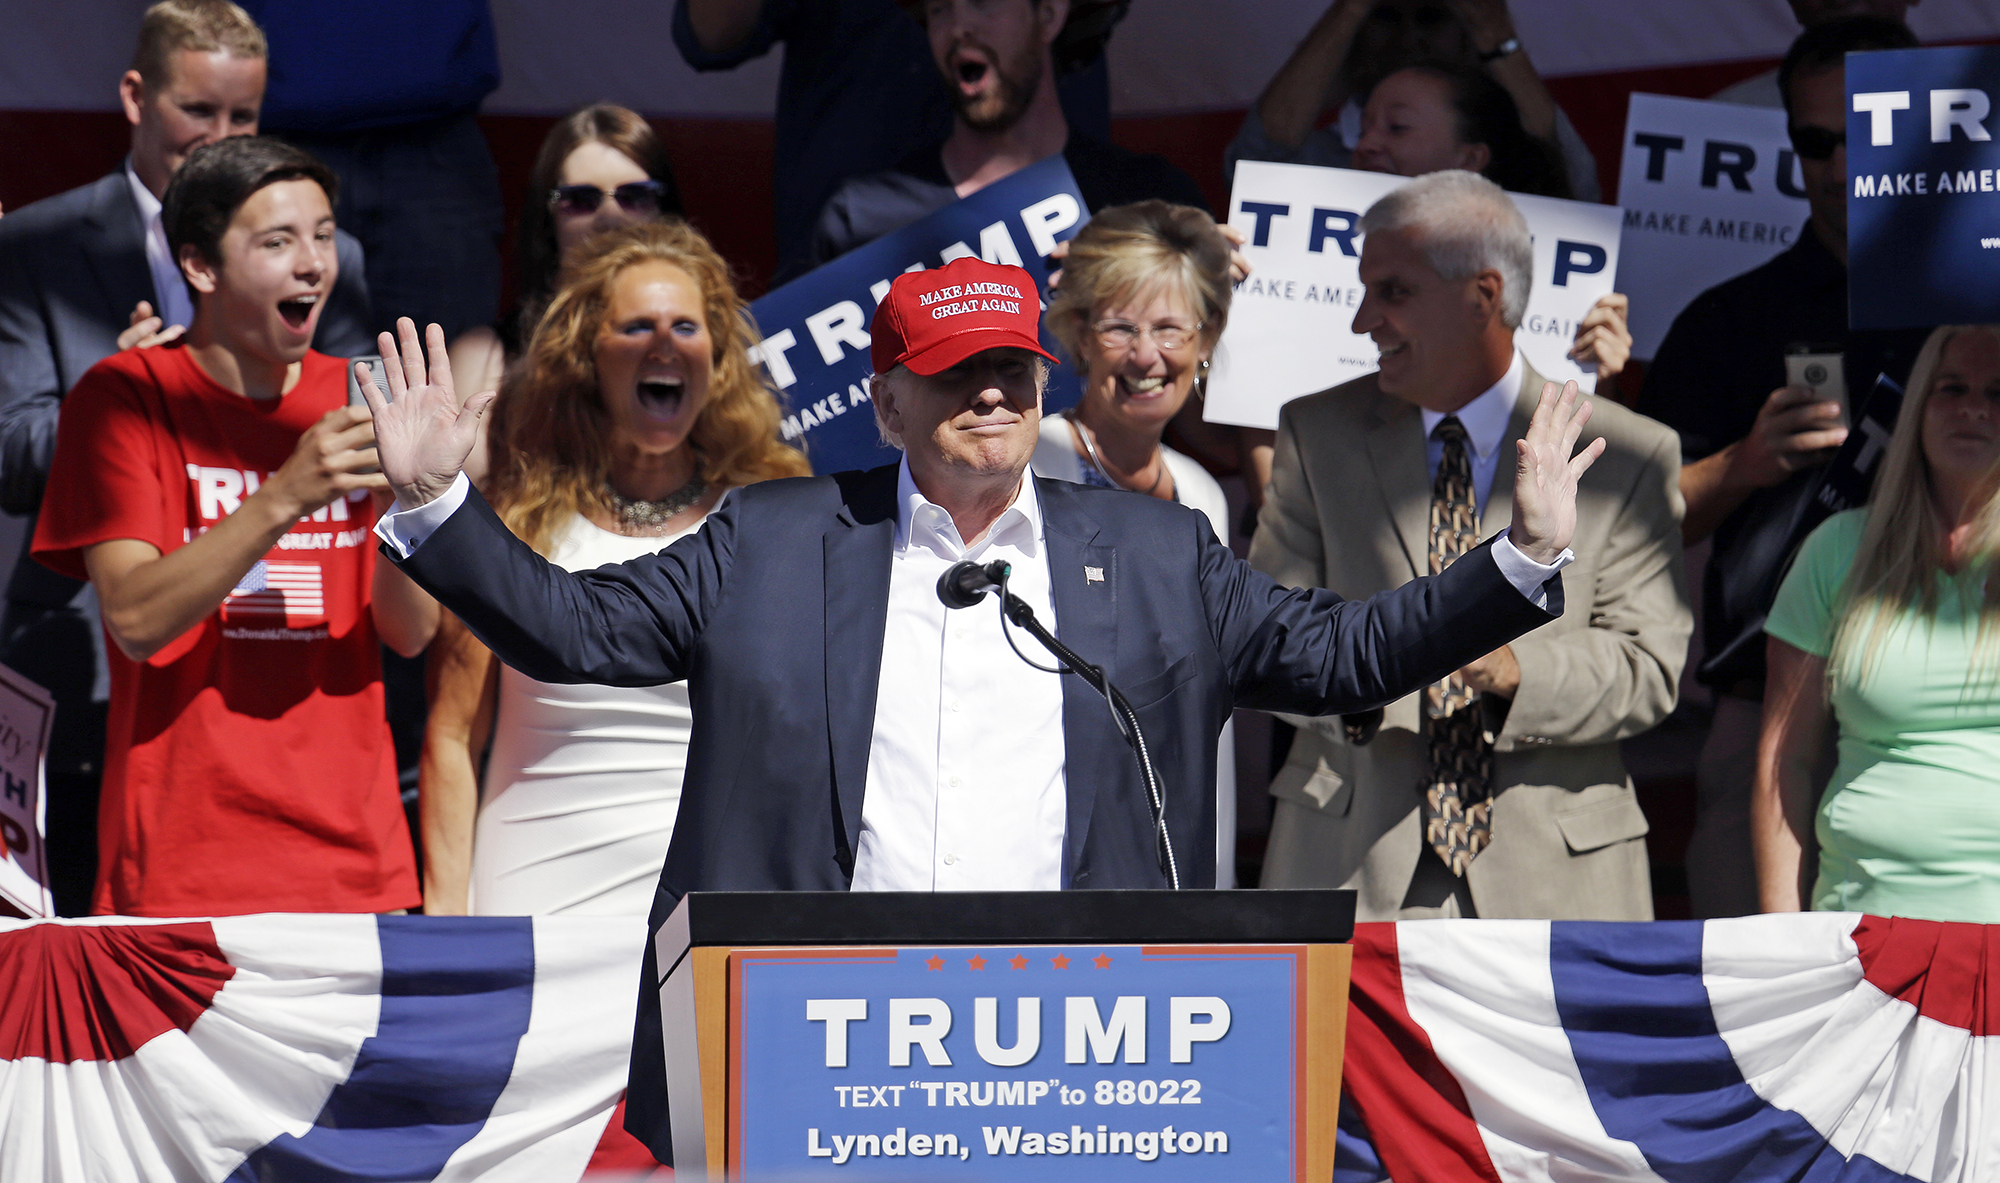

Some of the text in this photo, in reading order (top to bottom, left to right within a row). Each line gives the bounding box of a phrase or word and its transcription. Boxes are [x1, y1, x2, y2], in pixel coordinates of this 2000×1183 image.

[1855, 173, 1928, 198] MAKE
[1624, 210, 1794, 244] MAKE AMERIC
[919, 282, 1024, 307] MAKE AMERICA
[932, 299, 980, 320] GREAT
[981, 299, 1020, 314] AGAIN
[779, 391, 848, 441] MAKE
[806, 996, 1232, 1068] TRUMP
[834, 1085, 906, 1108] TEXT
[1059, 1084, 1087, 1106] to
[1093, 1079, 1202, 1106] 88022
[808, 1125, 1229, 1164] Lynden, Washington
